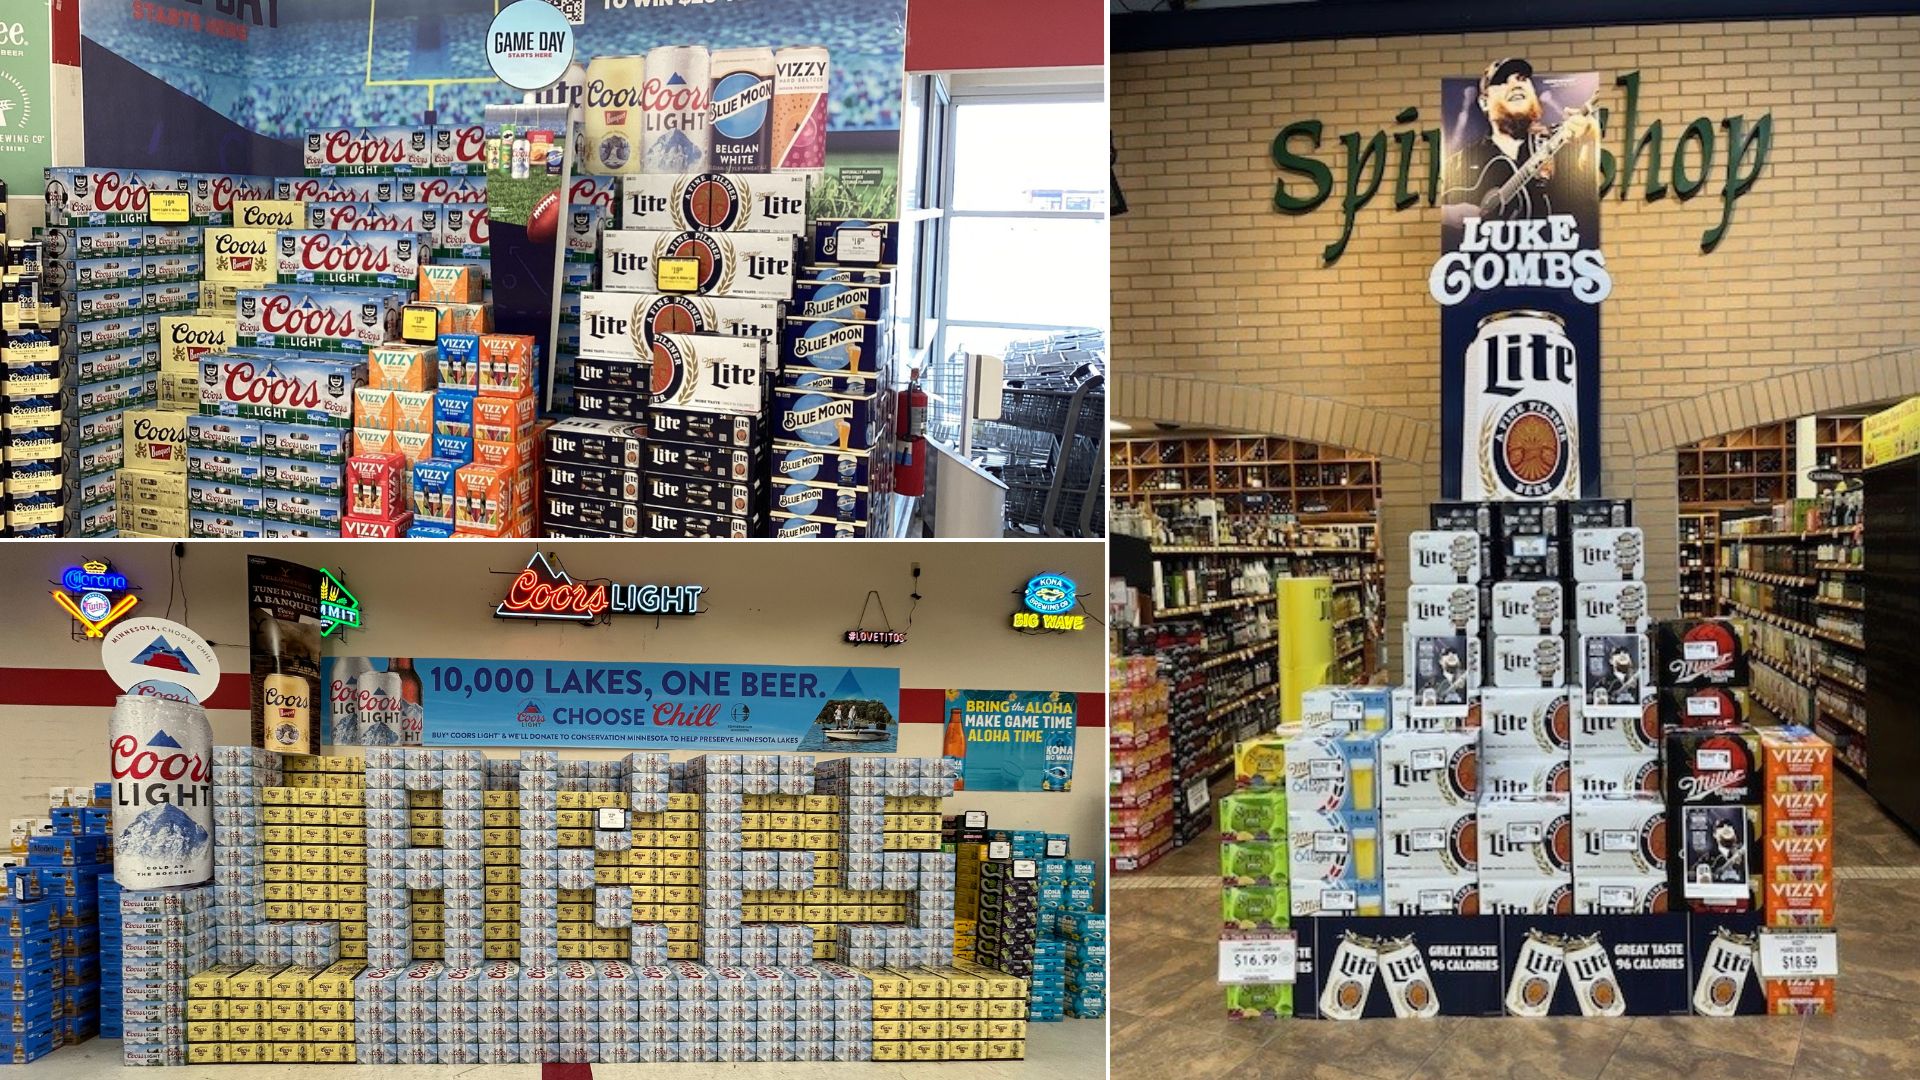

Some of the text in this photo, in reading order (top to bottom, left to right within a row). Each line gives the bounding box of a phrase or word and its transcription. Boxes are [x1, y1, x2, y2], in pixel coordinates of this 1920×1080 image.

[495, 31, 566, 54] GAME DAY
[777, 62, 827, 77] VIZZY
[642, 77, 709, 112] Coors
[709, 81, 772, 122] BLUE MOON
[647, 112, 704, 131] LIGHT
[325, 129, 407, 164] Coors
[716, 144, 759, 154] BELGIAN
[720, 154, 753, 165] WHITE
[350, 165, 378, 174] LIGHT
[712, 174, 738, 201] PILSNER
[631, 194, 667, 217] Lite
[762, 195, 802, 219] Lite
[244, 206, 294, 226] Coors
[1460, 215, 1579, 253] LUKE
[216, 233, 267, 255] Coors
[301, 233, 390, 271] Coors
[671, 232, 721, 261] FINE PILSNER
[612, 251, 648, 275] Lite
[748, 254, 789, 280] Lite
[329, 273, 360, 282] LIGHT
[424, 268, 464, 279] VIZZY
[1429, 249, 1612, 305] COMBS
[837, 291, 867, 308] MOON
[262, 294, 355, 337] Coors
[675, 297, 702, 327] PILSNER
[171, 322, 225, 345] Coors
[589, 313, 627, 339] Lite
[290, 336, 322, 347] LIGHT
[441, 338, 474, 349] VIZZY
[482, 339, 518, 350] VIZZY
[795, 328, 863, 355] BLUE MOON
[374, 353, 416, 366] VIZZY
[1483, 334, 1573, 397] Lite
[711, 361, 755, 389] Lite
[225, 362, 321, 408] Coors
[254, 406, 287, 419] LIGHT
[784, 403, 852, 429] BLUE MOON
[1500, 401, 1567, 442] FINE PILSNER
[134, 418, 186, 442] Coors
[459, 473, 495, 486] VIZZY
[1514, 483, 1552, 495] BEER
[345, 522, 392, 537] VIZZY
[1418, 550, 1447, 567] Lite
[1582, 549, 1610, 567] Lite
[504, 568, 702, 613] Coors LIGHT
[1040, 579, 1062, 587] KONA
[253, 585, 318, 604] TUNE IN WITH
[1029, 598, 1060, 610] BREWING
[264, 595, 318, 614] BANQUET
[1417, 603, 1445, 620] Lite
[1502, 602, 1529, 618] Lite
[1586, 601, 1614, 618] Lite
[1013, 612, 1085, 630] BIG WAVE
[161, 626, 214, 663] CHOOSE CHILL
[848, 631, 905, 643] #LOVETITOS
[1503, 654, 1531, 671] Lite
[430, 666, 826, 701] 10,000 LAKES, ONE BEER.
[265, 687, 309, 708] Coors
[357, 689, 401, 711] Coors
[966, 700, 1073, 714] BRING the ALOHA
[361, 711, 399, 723] LIGHT
[552, 702, 722, 727] CHOOSE Chill
[965, 714, 1073, 729] MAKE GAME TIME
[1493, 714, 1527, 735] Lite
[570, 734, 626, 742] CONSERVATION
[967, 729, 1043, 743] ALOHA TIME
[110, 735, 212, 783] Coors
[1046, 746, 1073, 755] KONA
[1772, 749, 1827, 763] VIZZY
[118, 782, 209, 806] LIGHT
[1679, 769, 1746, 800] Miller
[1772, 793, 1828, 807] VIZZY
[1771, 838, 1827, 852] VIZZY
[1772, 883, 1828, 897] VIZZY
[1429, 945, 1498, 957] GREAT TASTE
[1615, 943, 1684, 956] GREAT TASTE
[1234, 953, 1278, 967] $16.99
[1340, 951, 1376, 977] Lite
[1388, 950, 1422, 982] Lite
[1431, 959, 1499, 971] 96 CALORIES
[1526, 948, 1562, 974] Lite
[1573, 950, 1608, 981] Lite
[1616, 957, 1685, 970] 96 CALORIES
[1713, 949, 1750, 974] Lite
